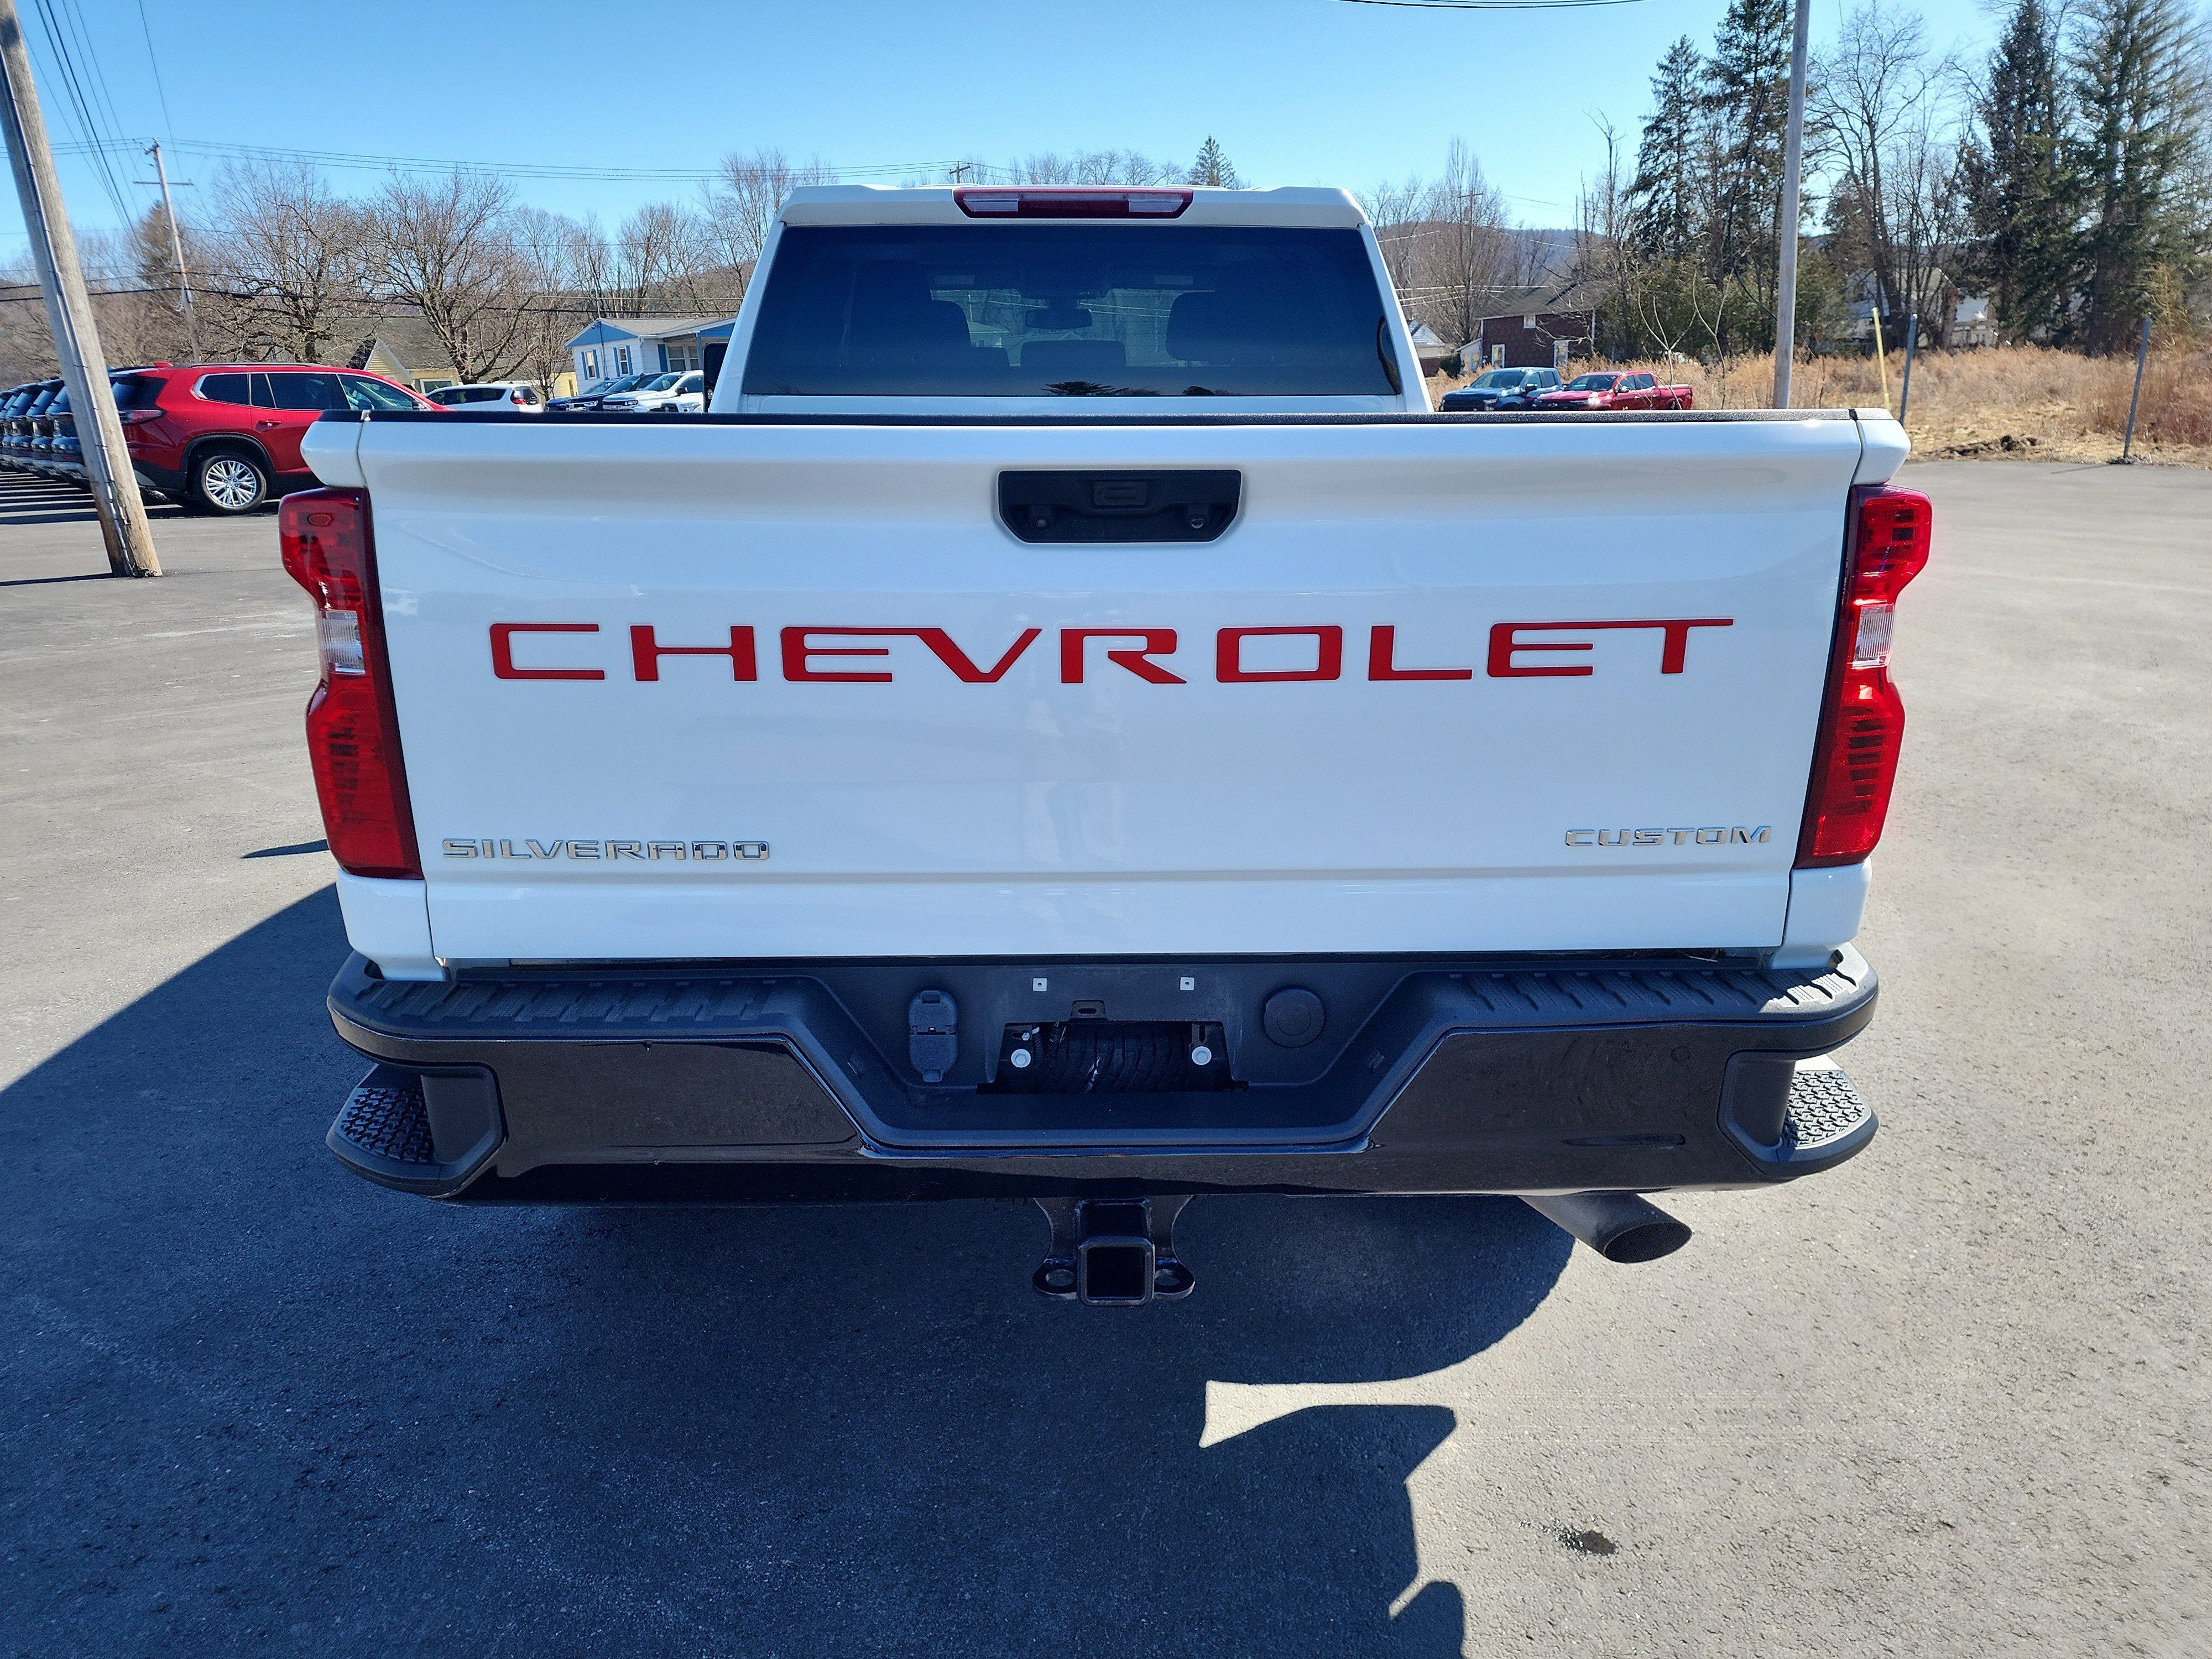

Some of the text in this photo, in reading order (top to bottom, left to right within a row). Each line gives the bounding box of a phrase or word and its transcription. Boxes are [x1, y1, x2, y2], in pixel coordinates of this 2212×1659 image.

[490, 619, 1733, 684] CHEVROLET
[1566, 826, 1772, 847] CUSTOM
[442, 838, 770, 860] SILVERADO
